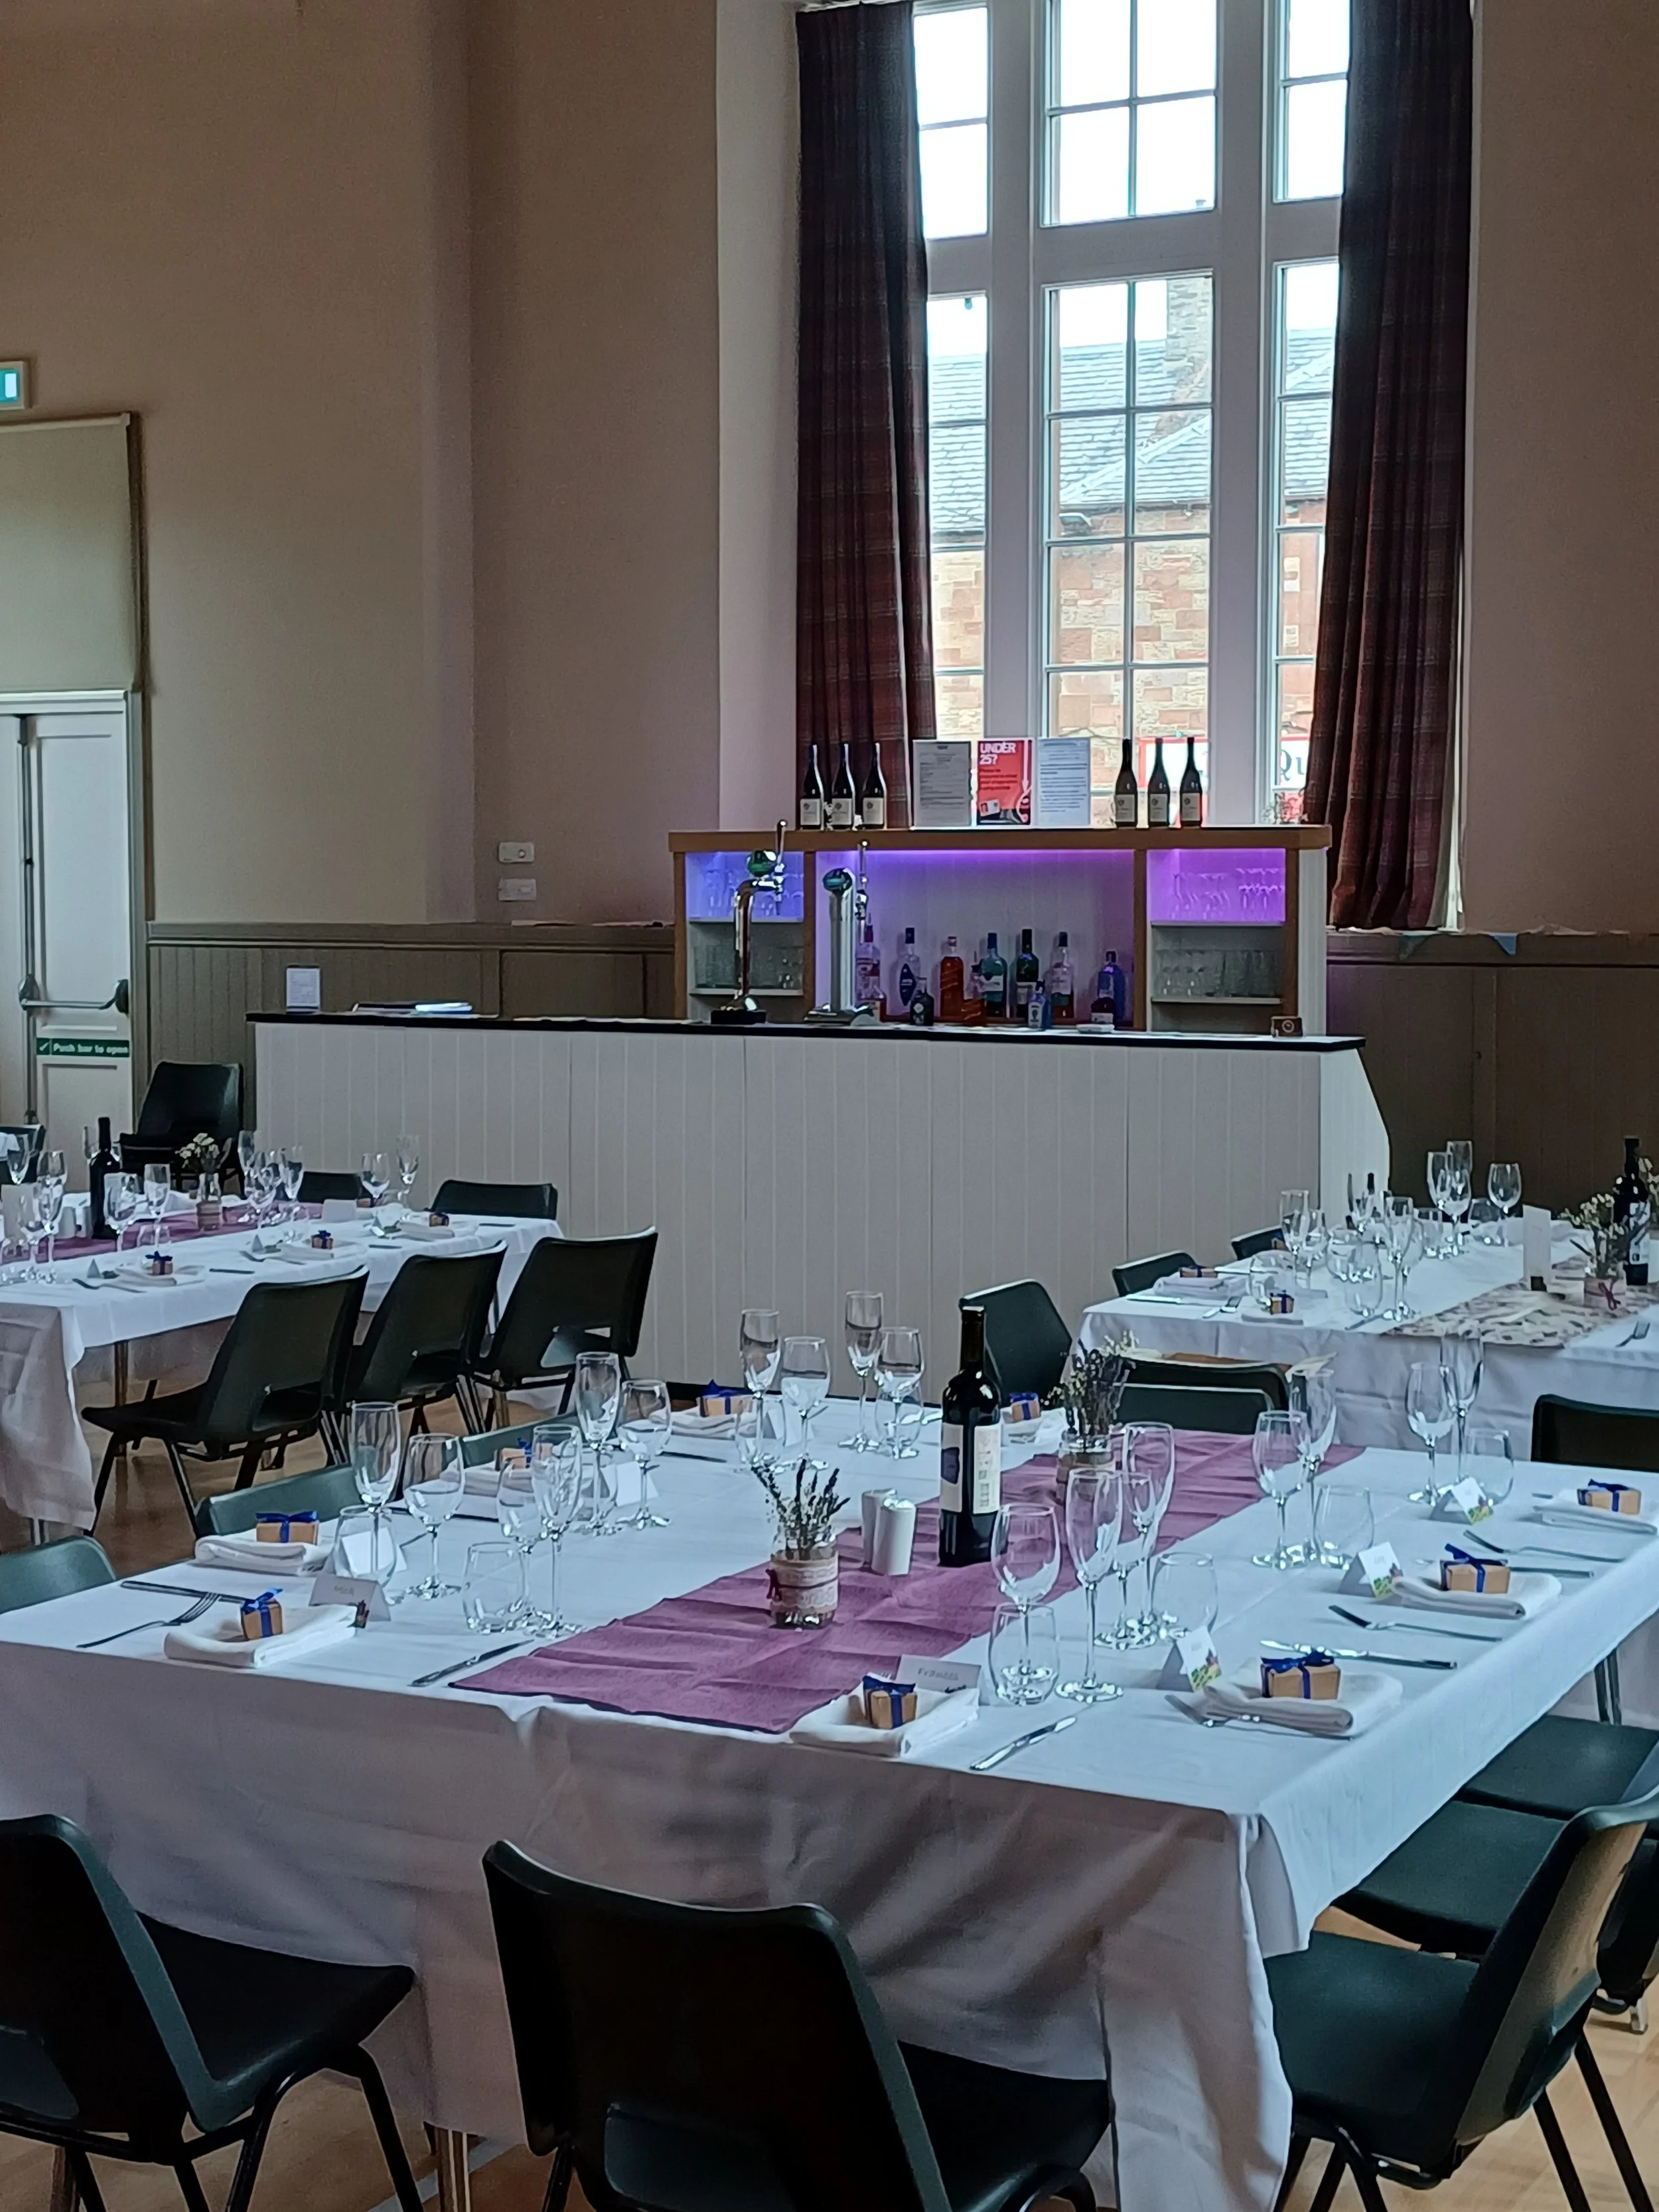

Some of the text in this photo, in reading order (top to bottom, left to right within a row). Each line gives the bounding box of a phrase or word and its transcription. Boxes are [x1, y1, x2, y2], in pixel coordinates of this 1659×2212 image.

[980, 741, 1017, 753] UNDER
[979, 753, 998, 765] 25?
[53, 1043, 75, 1053] Push
[94, 1045, 105, 1053] to
[106, 1046, 128, 1055] open
